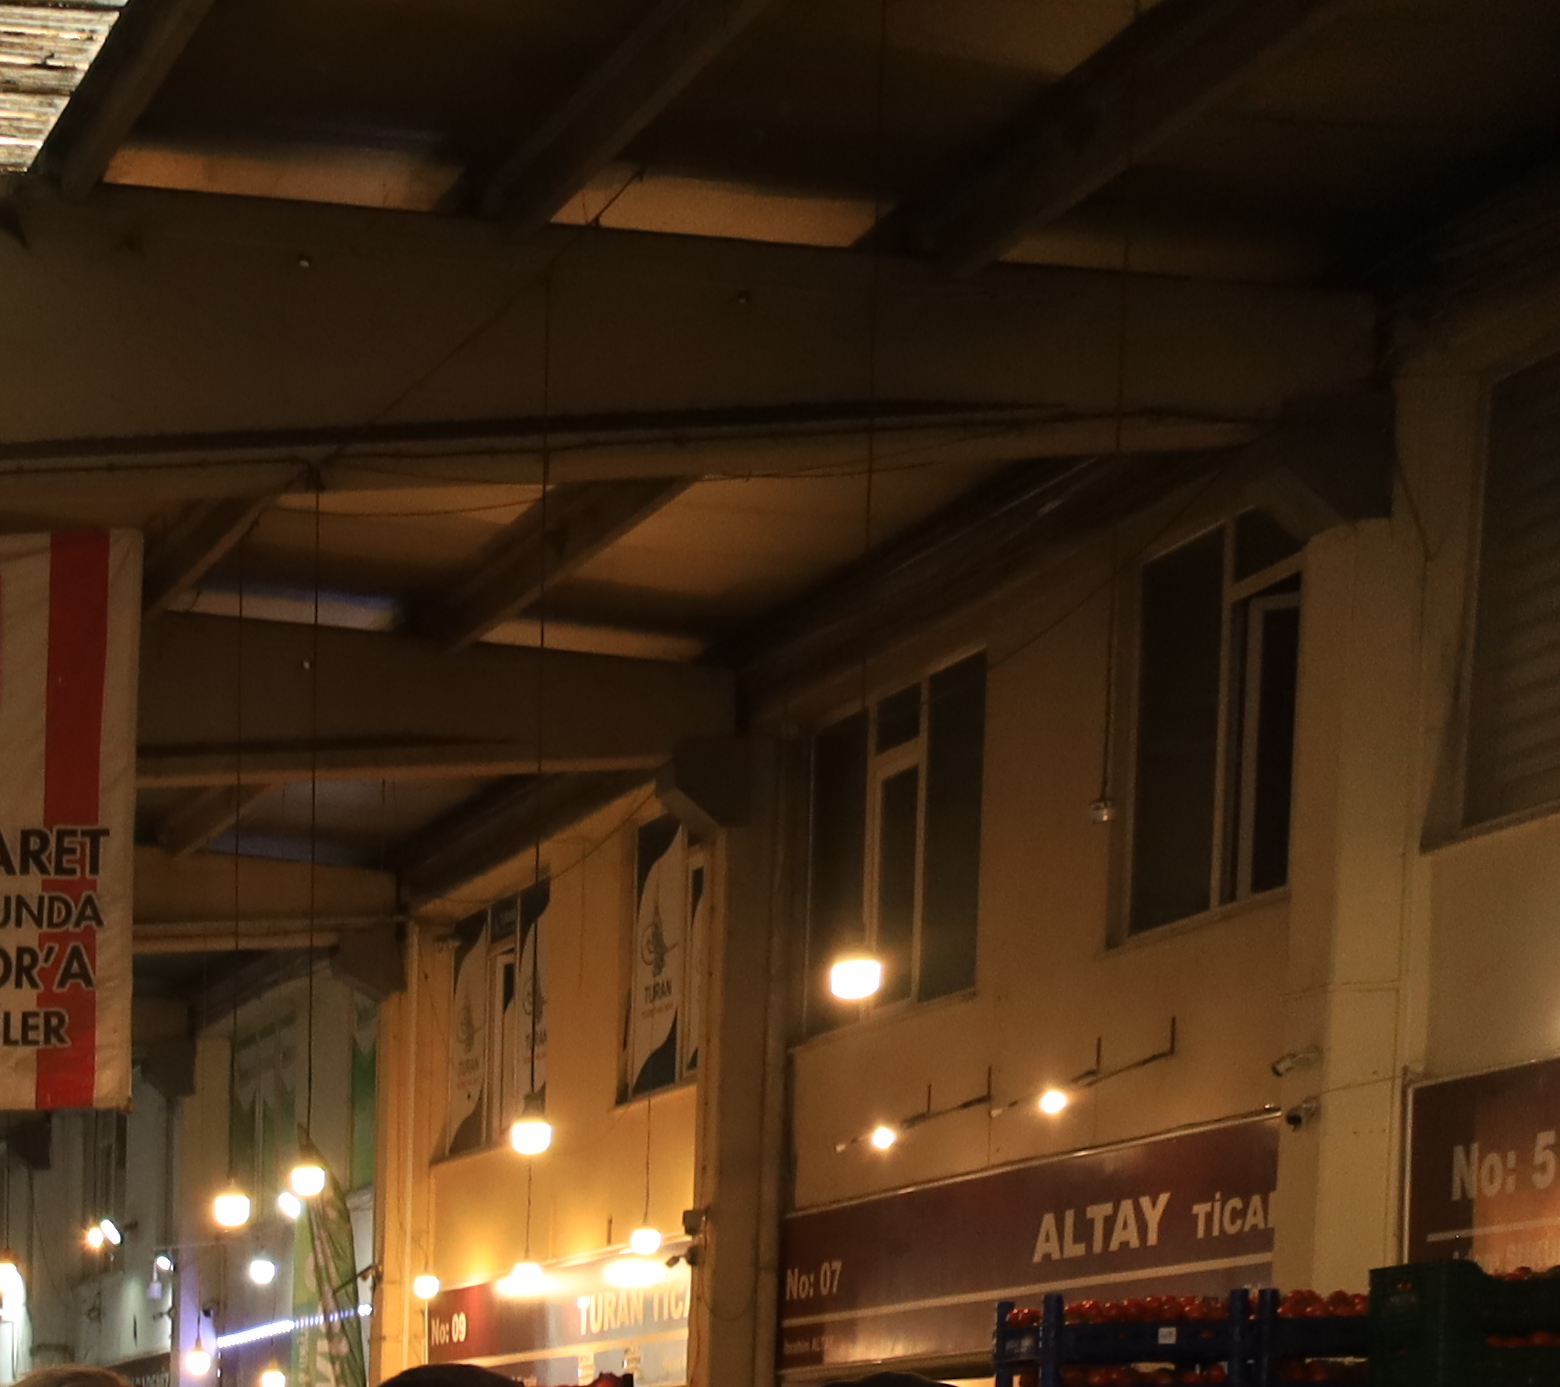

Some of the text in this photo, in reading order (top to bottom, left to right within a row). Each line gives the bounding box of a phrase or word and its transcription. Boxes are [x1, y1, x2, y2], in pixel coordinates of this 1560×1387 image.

[1451, 1141, 1517, 1201] No:
[1032, 1192, 1172, 1264] ALTAY
[786, 1260, 843, 1301] No: 07
[430, 1317, 450, 1347] No:
[451, 1311, 467, 1344] 09
[576, 1285, 644, 1337] TURAN
